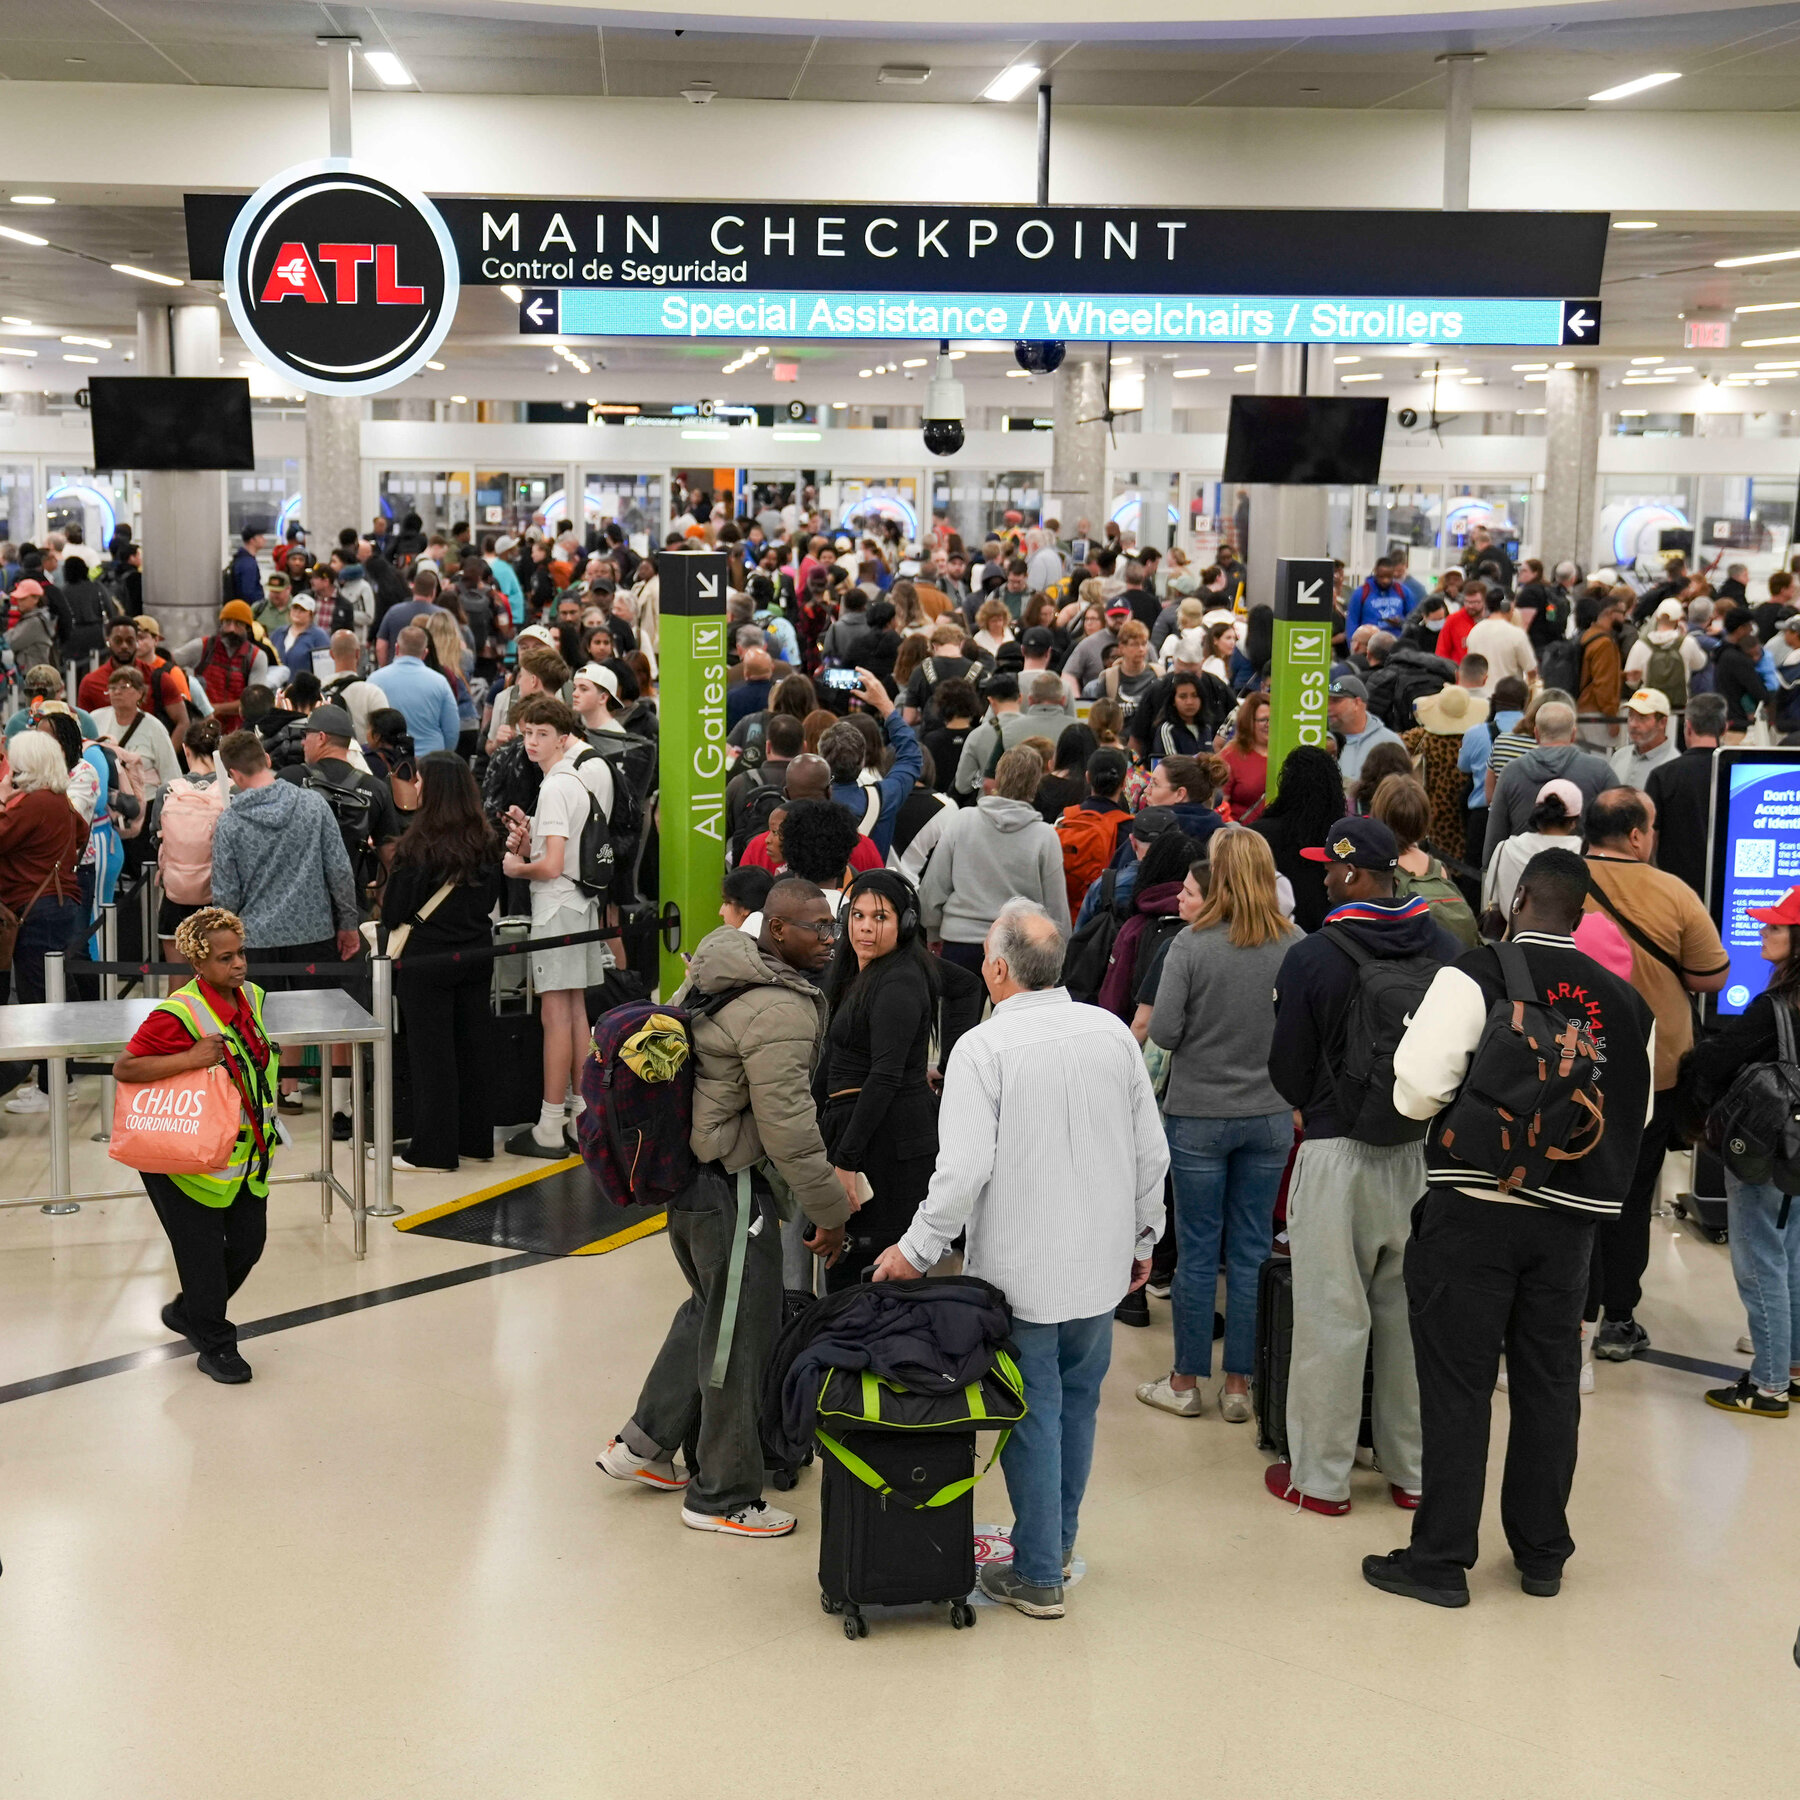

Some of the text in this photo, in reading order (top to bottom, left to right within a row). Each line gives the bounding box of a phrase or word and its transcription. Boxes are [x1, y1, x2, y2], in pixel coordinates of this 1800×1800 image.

[482, 212, 1187, 260] MAIN CHECKPOINT
[260, 242, 424, 304] ATL
[481, 257, 747, 286] Control de Seguridad
[661, 295, 1463, 337] Special Assistance / Wheelchairs / Strollers
[697, 401, 715, 416] 10
[790, 402, 803, 418] 9
[1403, 411, 1413, 425] 7
[1292, 671, 1325, 746] ates
[691, 664, 724, 841] All Gates
[1763, 790, 1795, 801] Don't
[1753, 817, 1767, 829] of
[1778, 842, 1796, 850] Scan
[1778, 850, 1791, 858] the
[1778, 859, 1790, 867] fee
[132, 1088, 206, 1118] CHAOS
[125, 1114, 200, 1136] COORDINATOR
